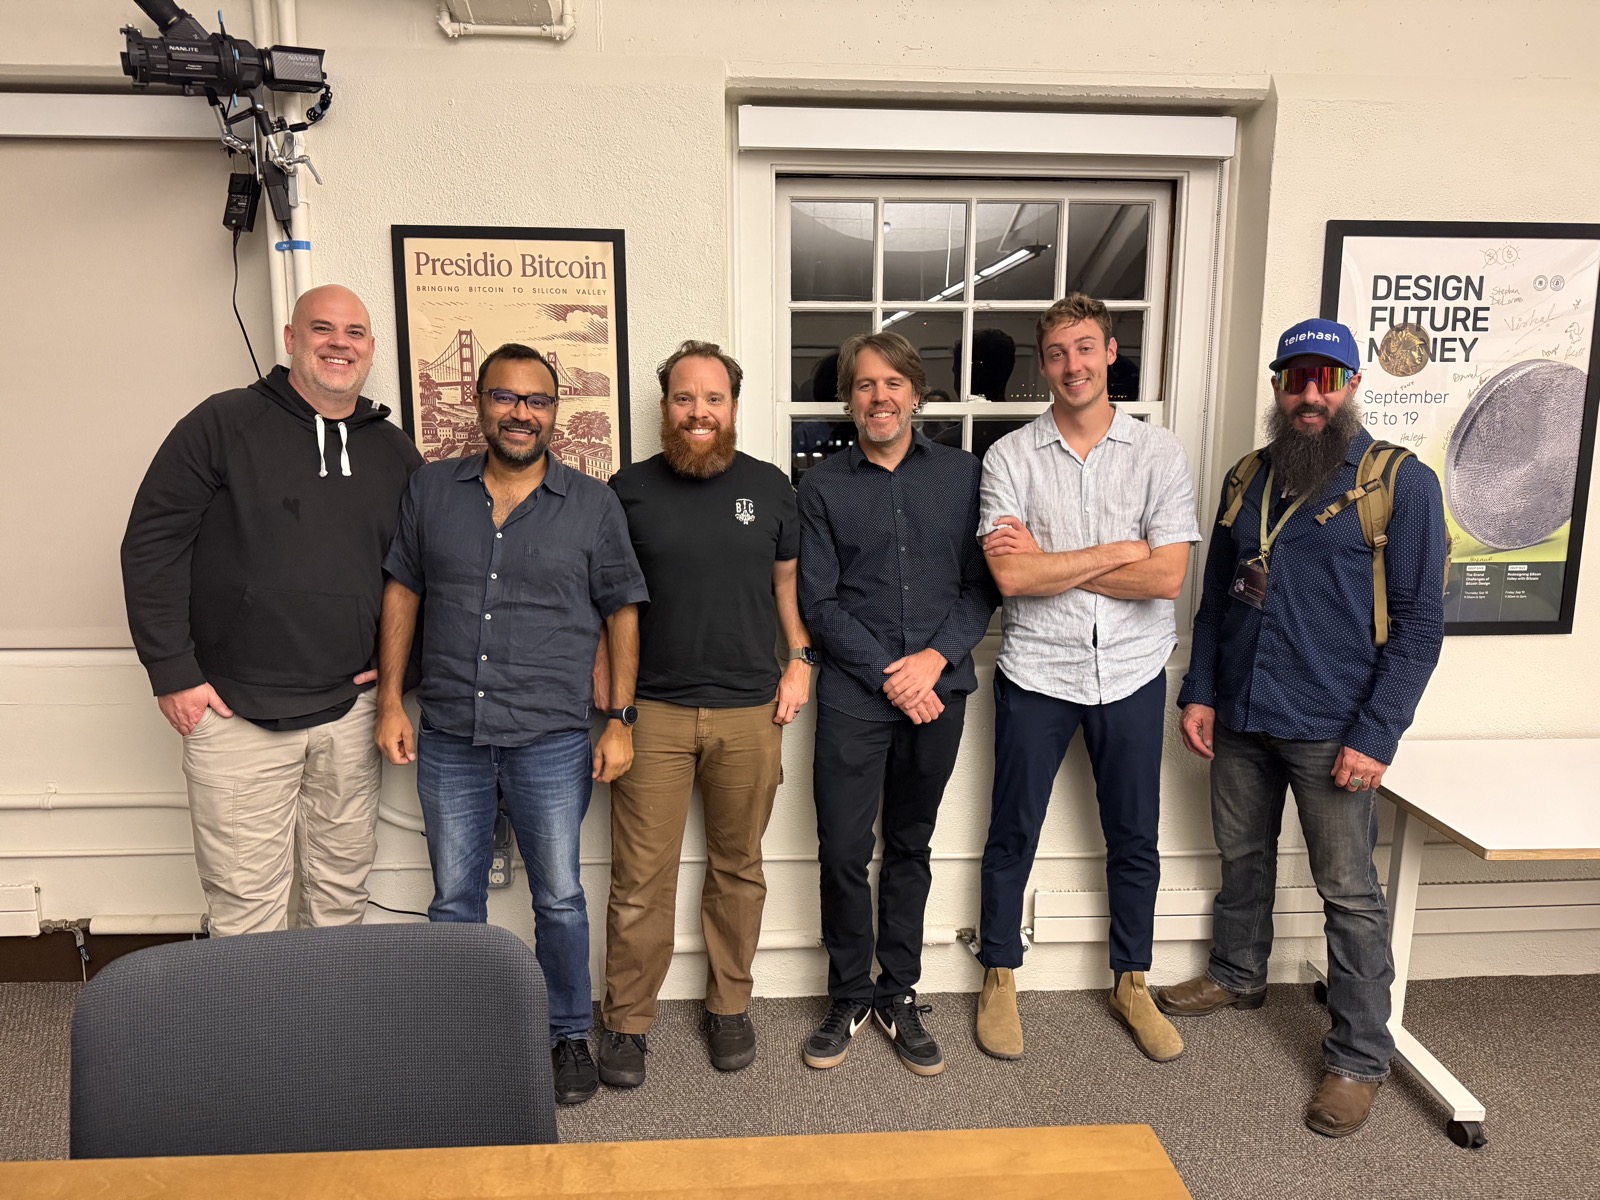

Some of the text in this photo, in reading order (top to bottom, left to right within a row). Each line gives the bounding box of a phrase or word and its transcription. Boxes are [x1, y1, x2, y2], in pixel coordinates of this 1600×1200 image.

[414, 251, 607, 280] Presidio Bitcoin
[1371, 274, 1485, 301] DESIGN
[1369, 306, 1491, 332] FUTURE
[1284, 331, 1340, 346] telehash
[1367, 337, 1479, 363] MNEY
[1364, 390, 1450, 407] September
[1362, 411, 1419, 425] 15 to 19
[1400, 433, 1427, 447] Haley
